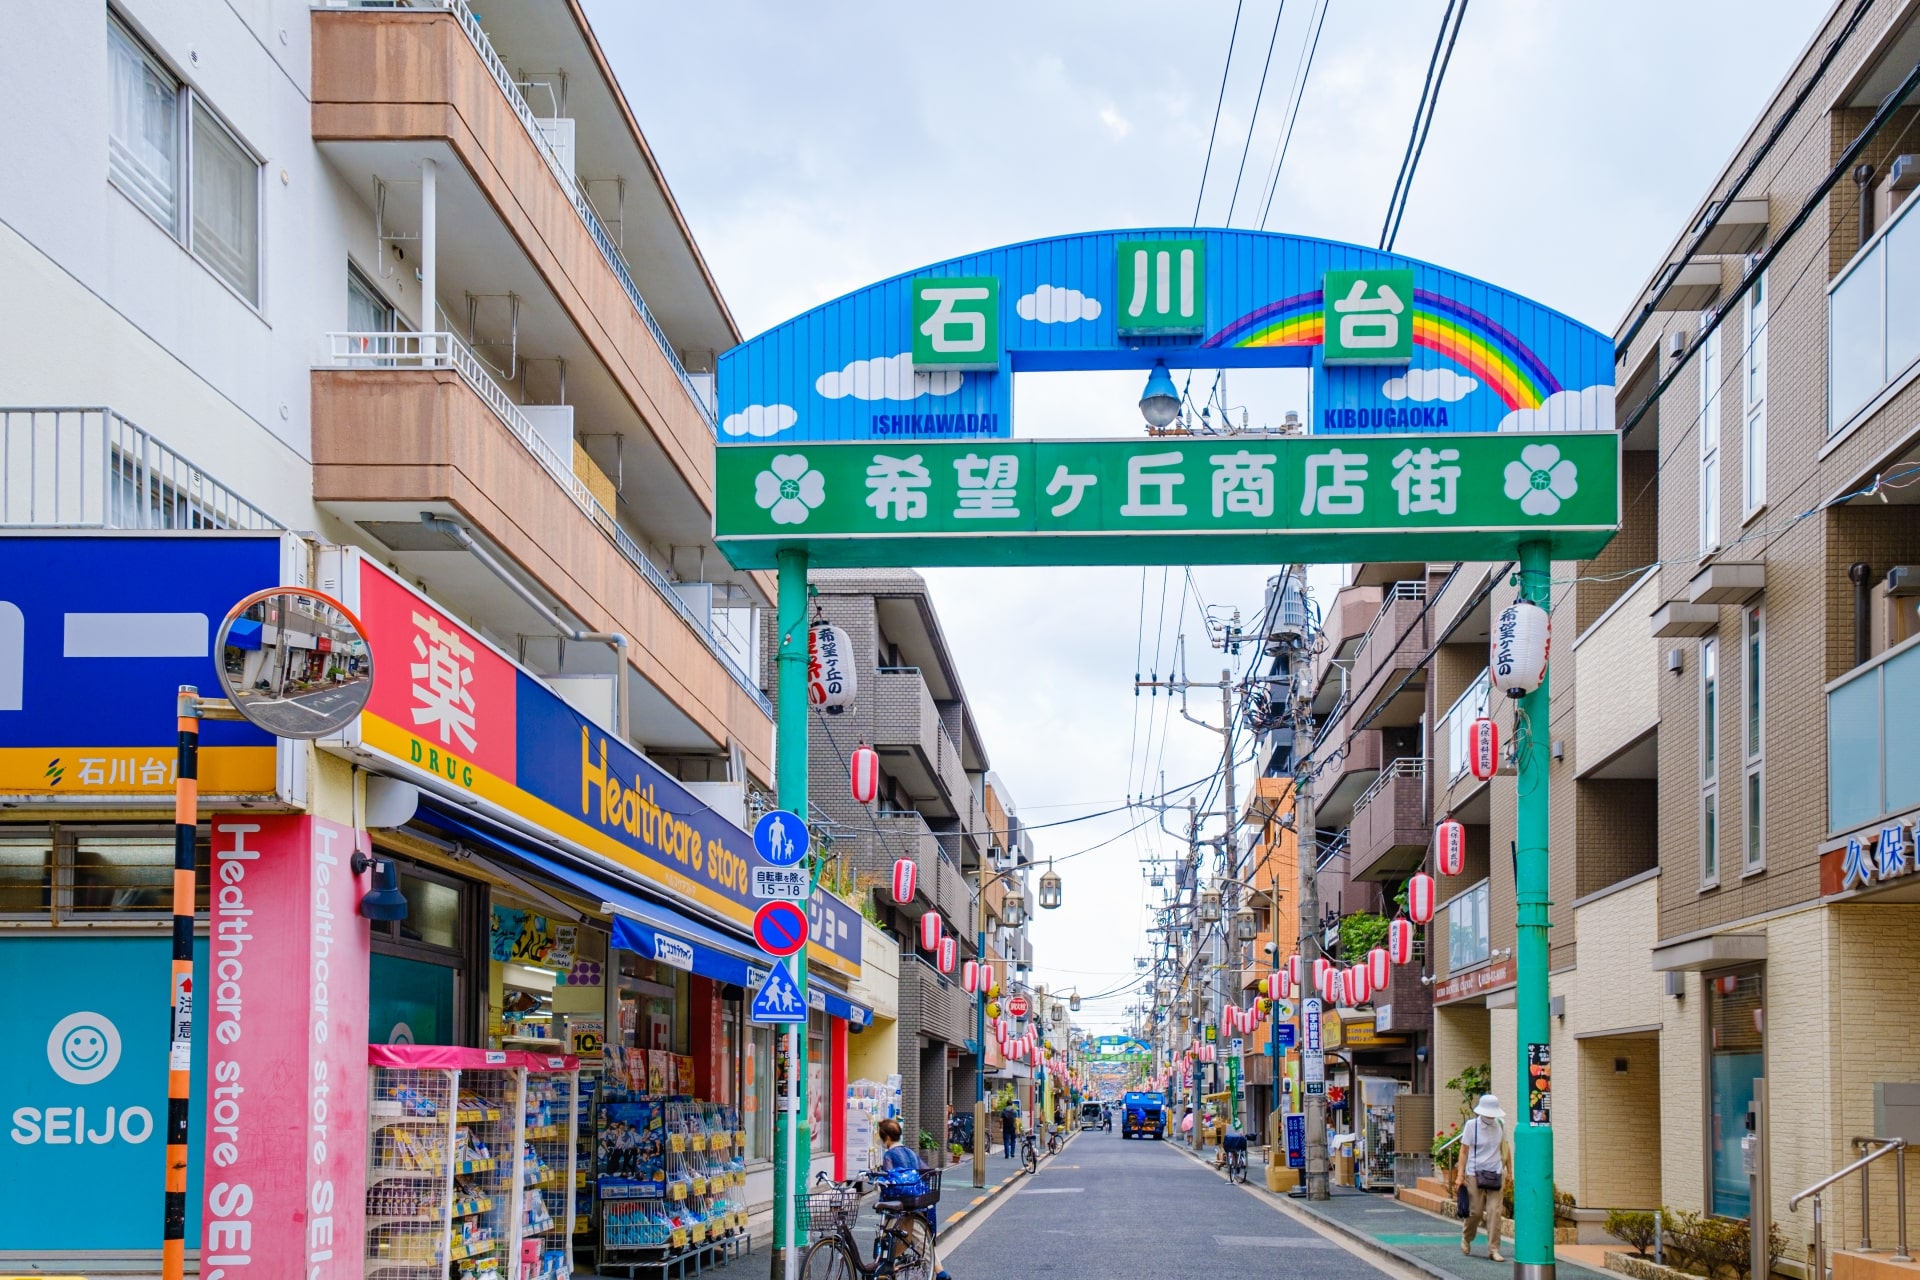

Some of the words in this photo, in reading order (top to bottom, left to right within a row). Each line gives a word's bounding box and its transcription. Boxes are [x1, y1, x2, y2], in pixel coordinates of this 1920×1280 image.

[919, 287, 989, 355] 石
[1129, 248, 1196, 319] 川
[1337, 281, 1404, 350] 台
[871, 412, 999, 435] ISHIKAWADAI
[1323, 406, 1449, 430] KIBOUGAOKA
[864, 446, 1462, 520] 希望ヶ丘商店街
[410, 609, 479, 755] 薬
[410, 738, 474, 788] DRUG
[581, 724, 703, 871] Healthcare
[707, 837, 748, 895] store
[757, 871, 805, 883] 自転車を除く
[214, 823, 261, 1046] Healthcare
[310, 824, 339, 1046] Healthcare
[177, 996, 193, 1040] 注意
[10, 1105, 154, 1145] SEIJO
[211, 1060, 246, 1168] store
[309, 1059, 330, 1167] store
